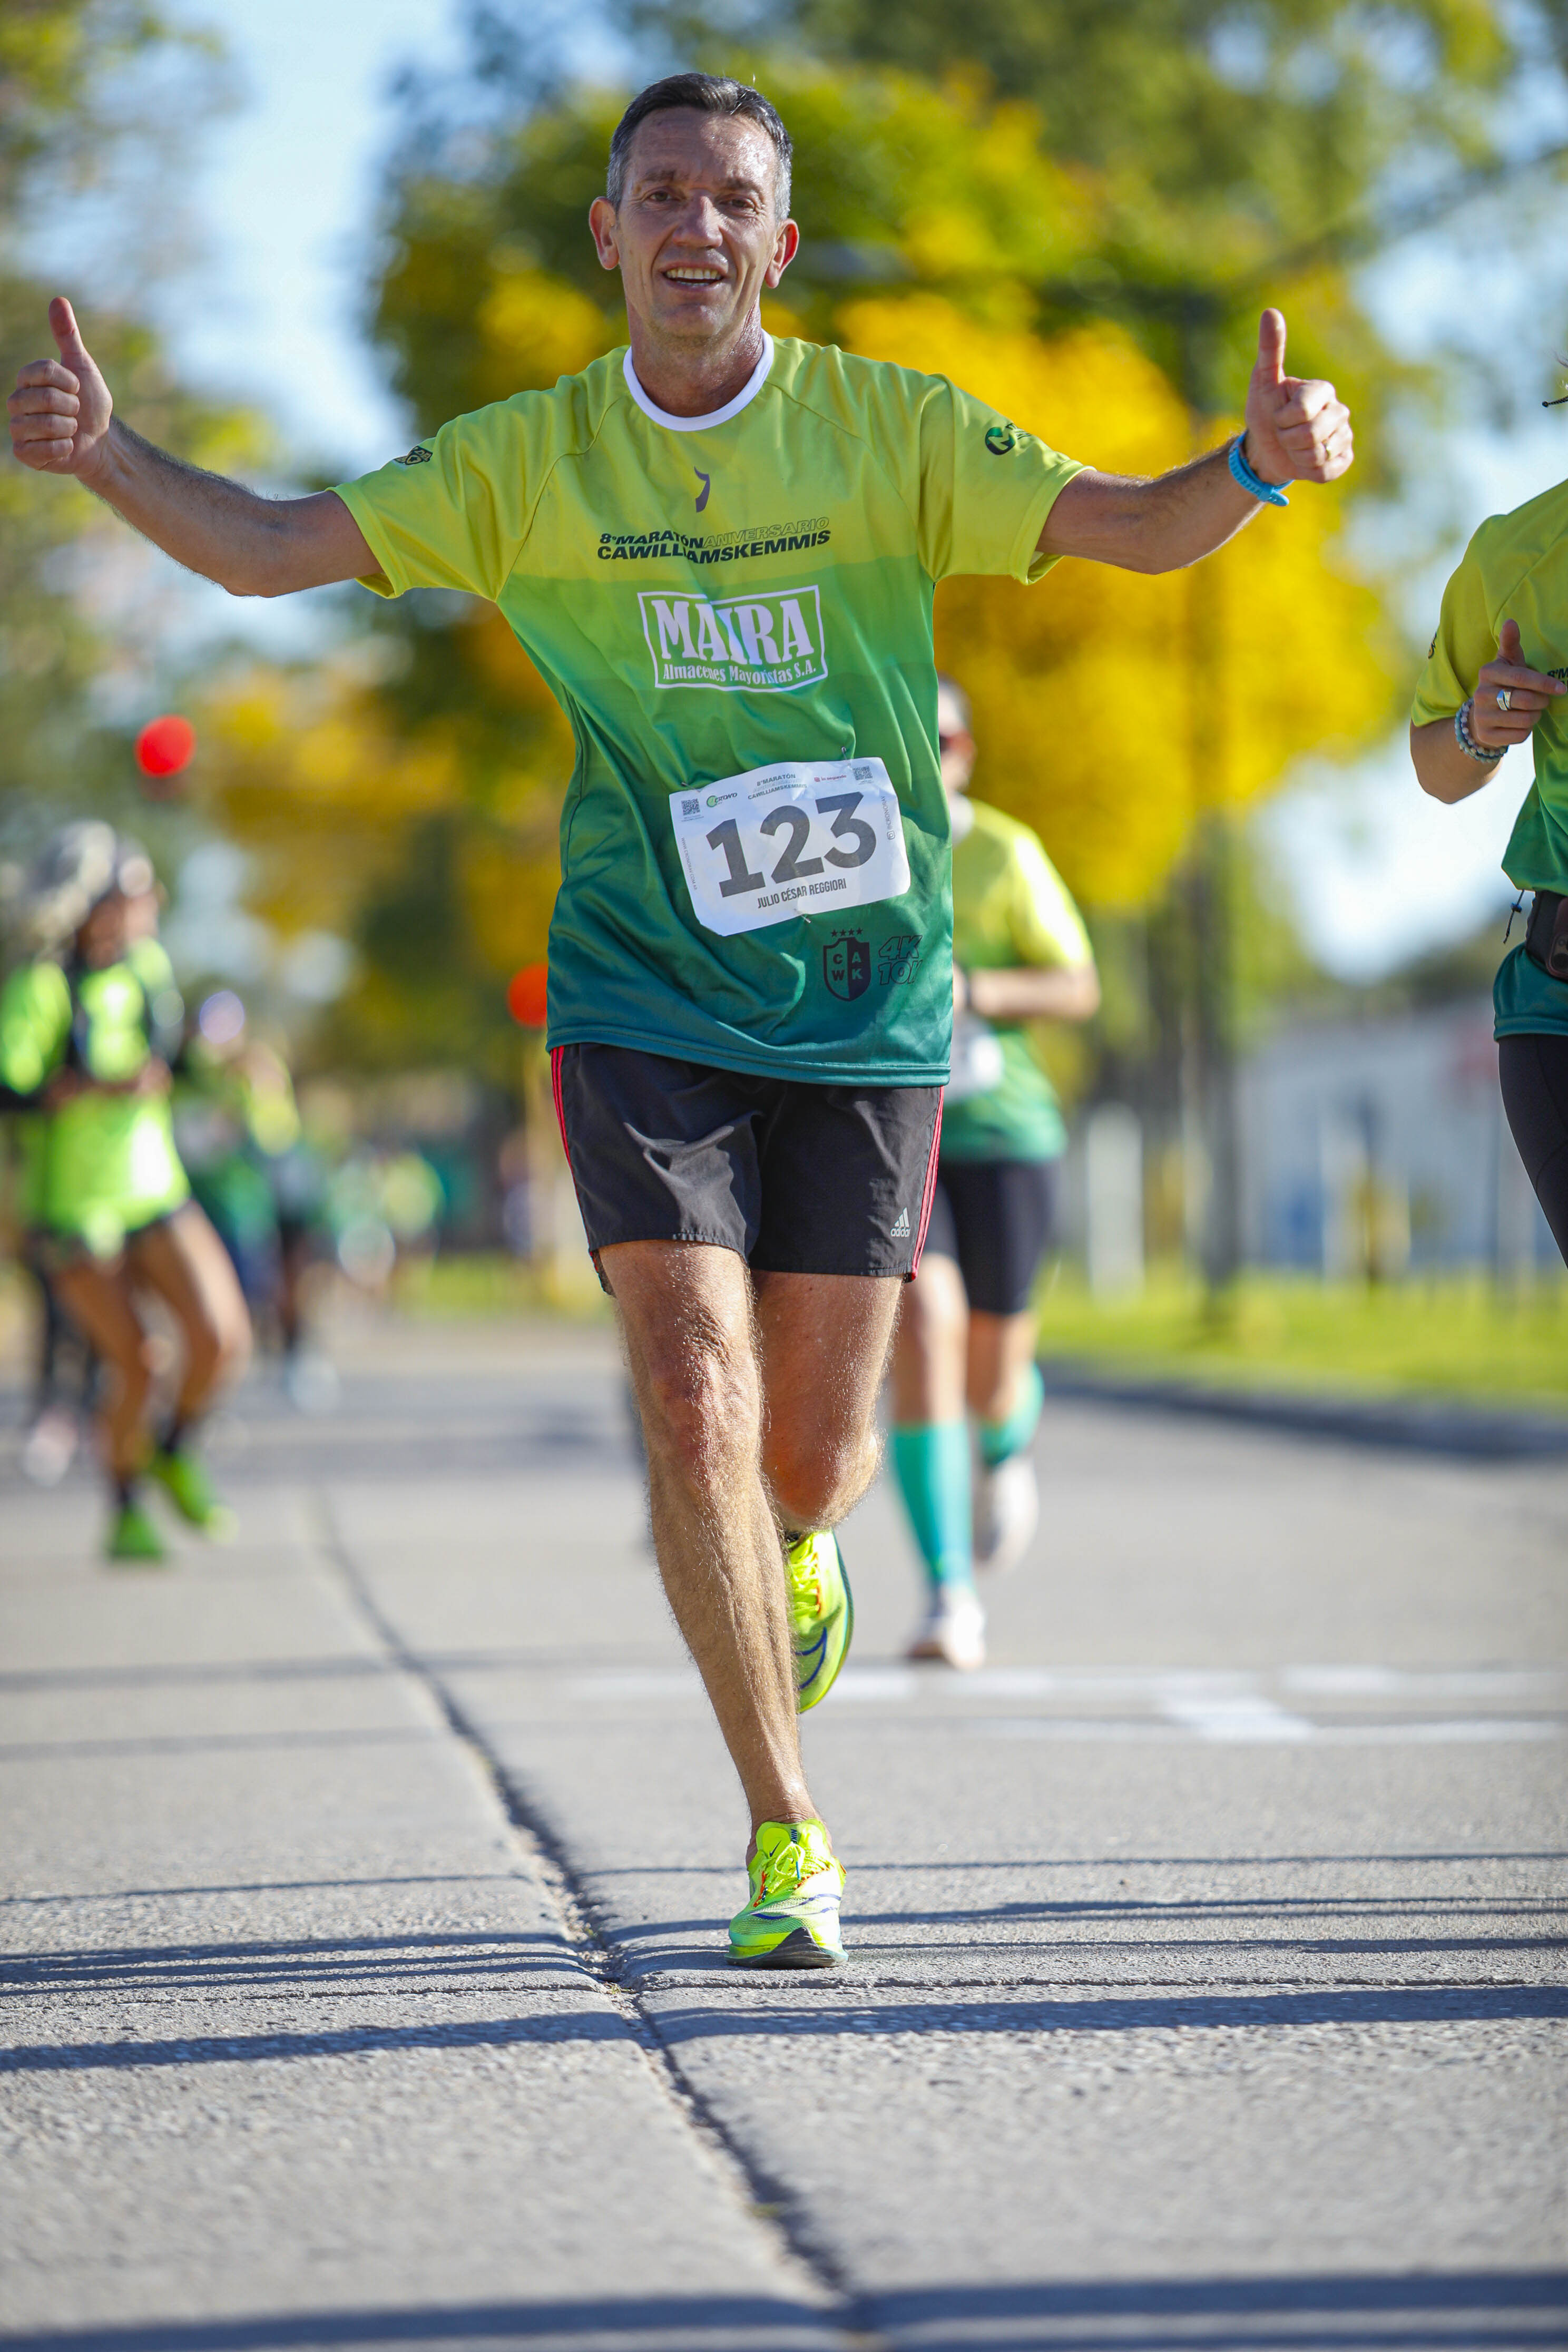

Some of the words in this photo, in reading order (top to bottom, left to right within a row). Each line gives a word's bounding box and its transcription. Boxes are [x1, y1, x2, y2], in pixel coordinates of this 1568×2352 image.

[597, 530, 831, 564] CAWILLIAMSKEMMIS
[651, 599, 815, 665] MAIRA
[663, 663, 726, 682] Almacenes
[729, 665, 793, 684] Mayoristas
[794, 659, 816, 678] S.A.
[705, 791, 877, 898] 123
[758, 893, 780, 909] JULIO
[781, 885, 807, 902] CÉSAR
[808, 878, 847, 895] REGGIORI
[878, 934, 923, 961] 4K
